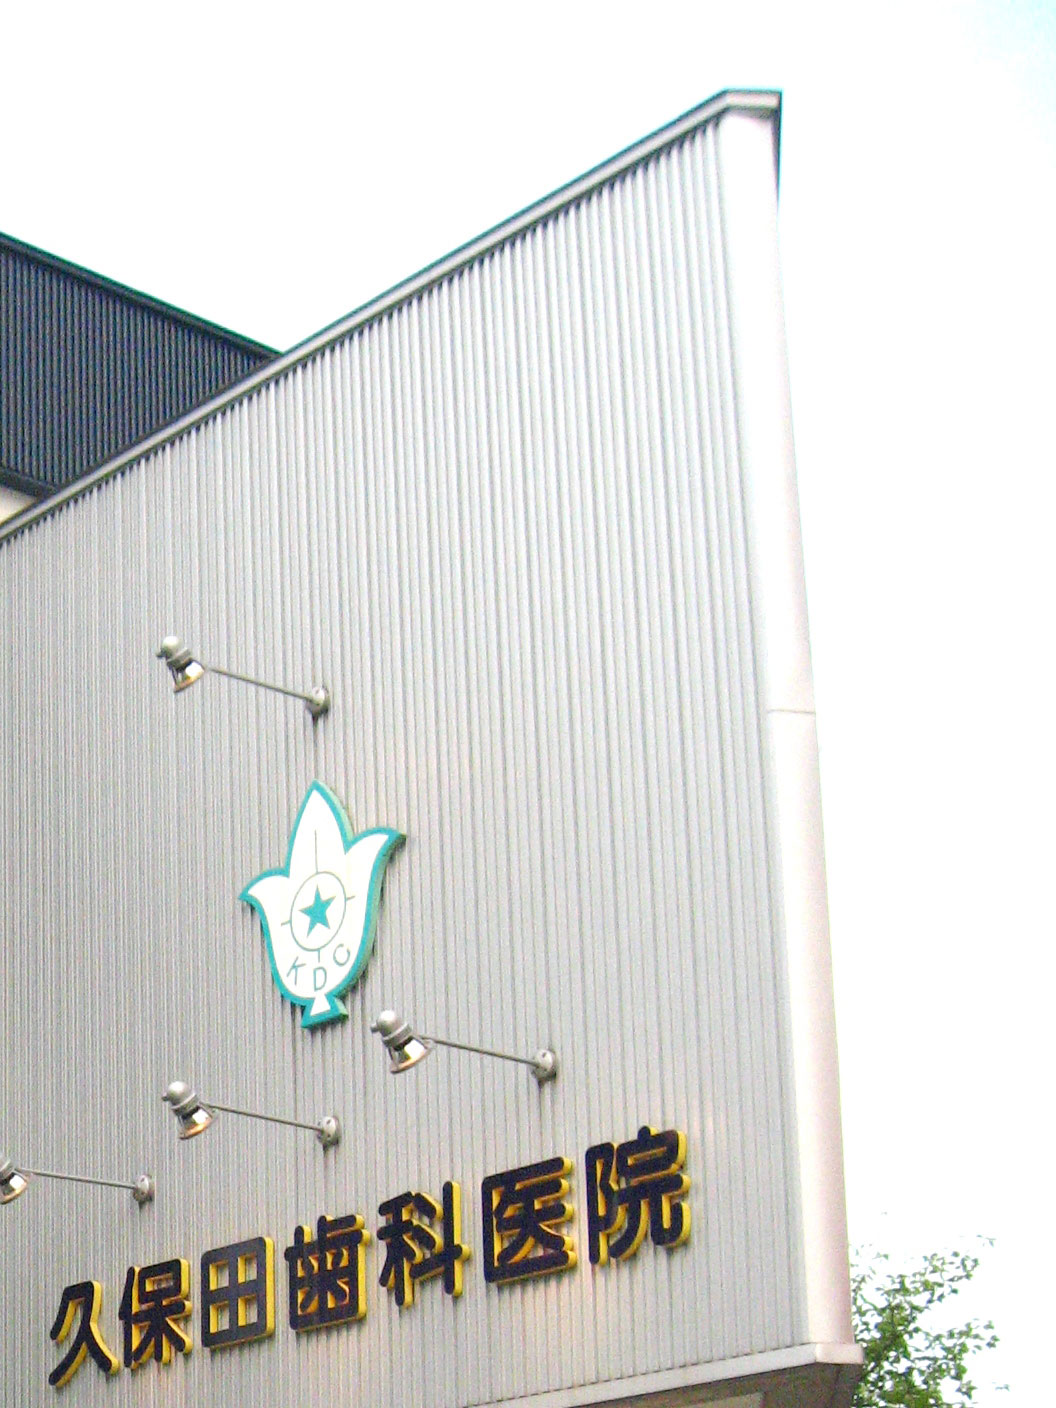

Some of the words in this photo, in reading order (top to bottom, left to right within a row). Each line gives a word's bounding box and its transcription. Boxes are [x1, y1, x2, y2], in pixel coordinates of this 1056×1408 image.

[286, 942, 351, 992] KDC
[48, 1126, 691, 1389] 久保田歯科医院
